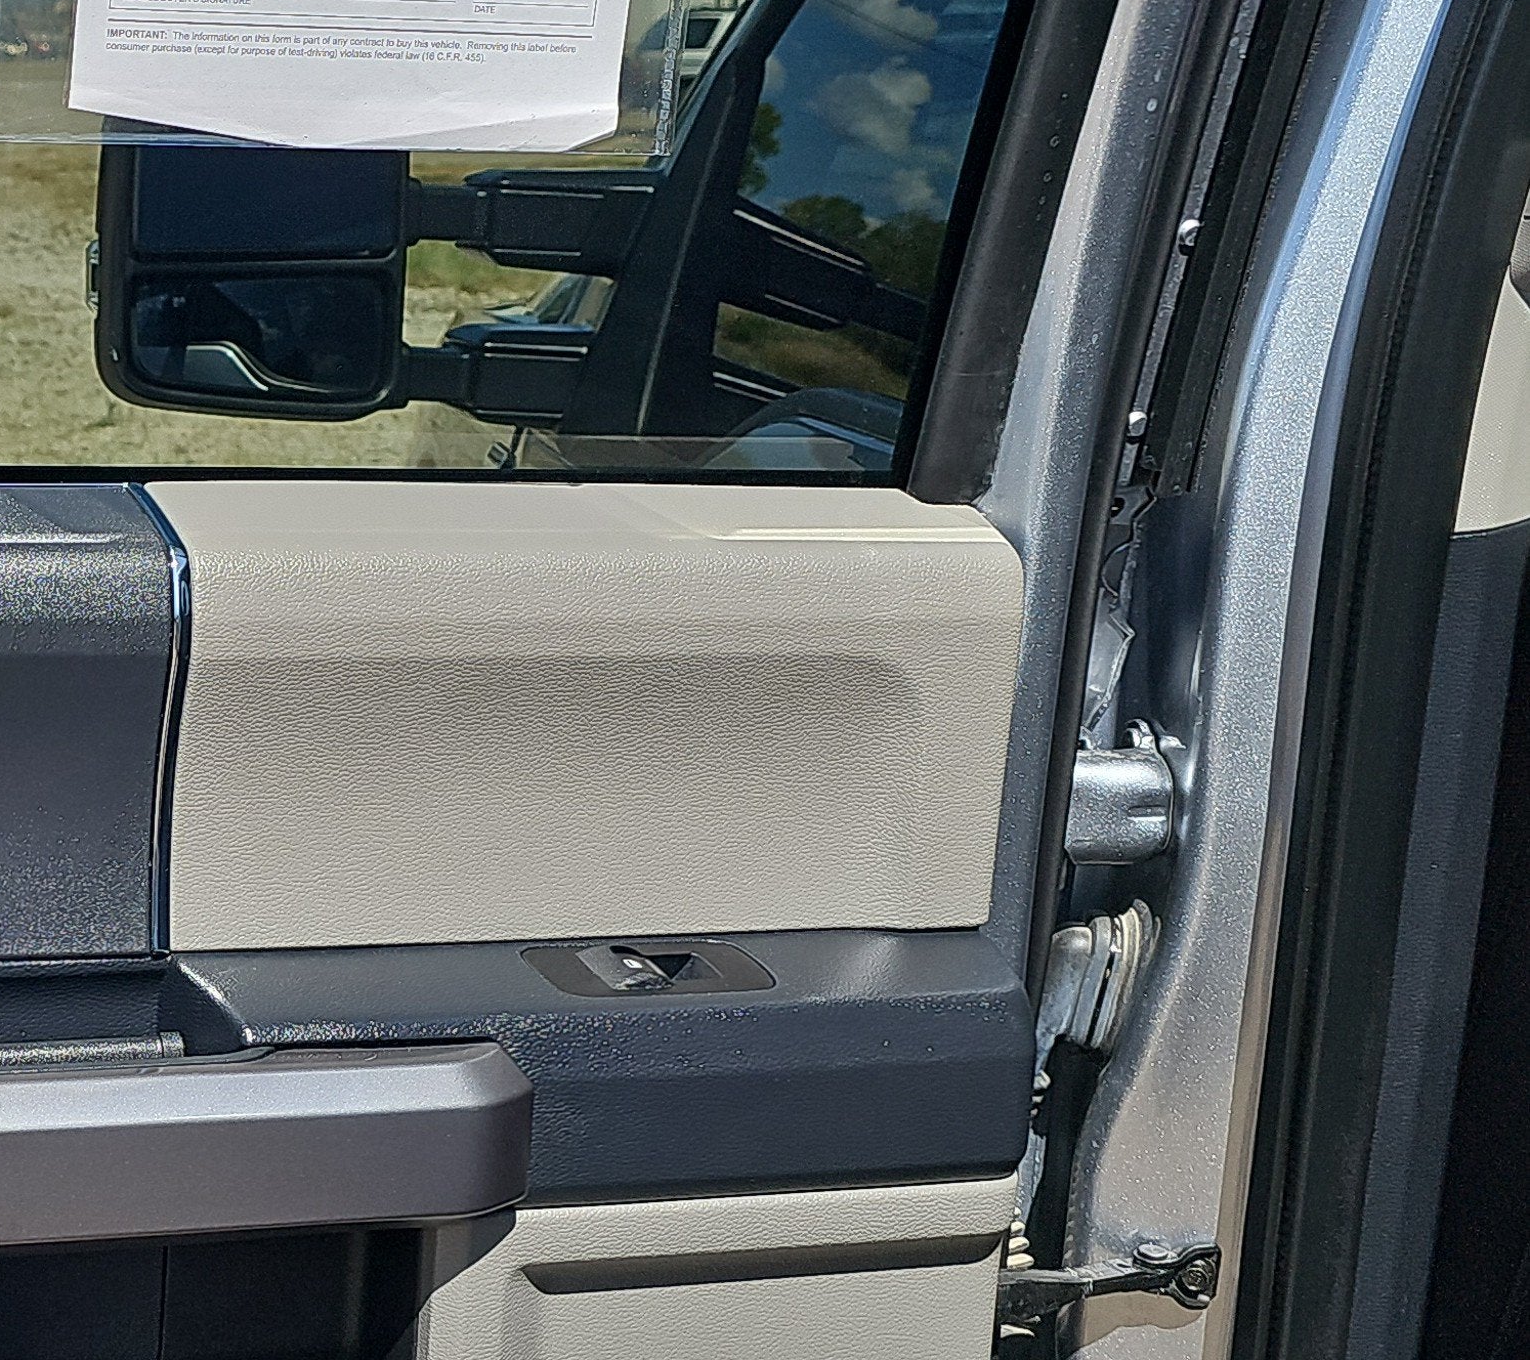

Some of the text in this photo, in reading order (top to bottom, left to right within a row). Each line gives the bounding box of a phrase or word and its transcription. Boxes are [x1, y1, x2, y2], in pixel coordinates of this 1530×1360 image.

[473, 4, 496, 14] DATE
[106, 28, 168, 39] IMPORTANT:
[466, 40, 509, 53] Removing
[509, 42, 526, 52] this
[526, 43, 548, 53] label
[548, 44, 577, 54] before
[105, 42, 150, 50] consumer
[151, 42, 192, 55] purchase
[193, 43, 226, 56] (except
[226, 45, 239, 54] for
[240, 47, 276, 57] purpose
[277, 46, 287, 55] of
[339, 49, 373, 58] violates
[373, 50, 404, 59] federal
[404, 51, 420, 60] law
[435, 52, 462, 62] C.F.R.
